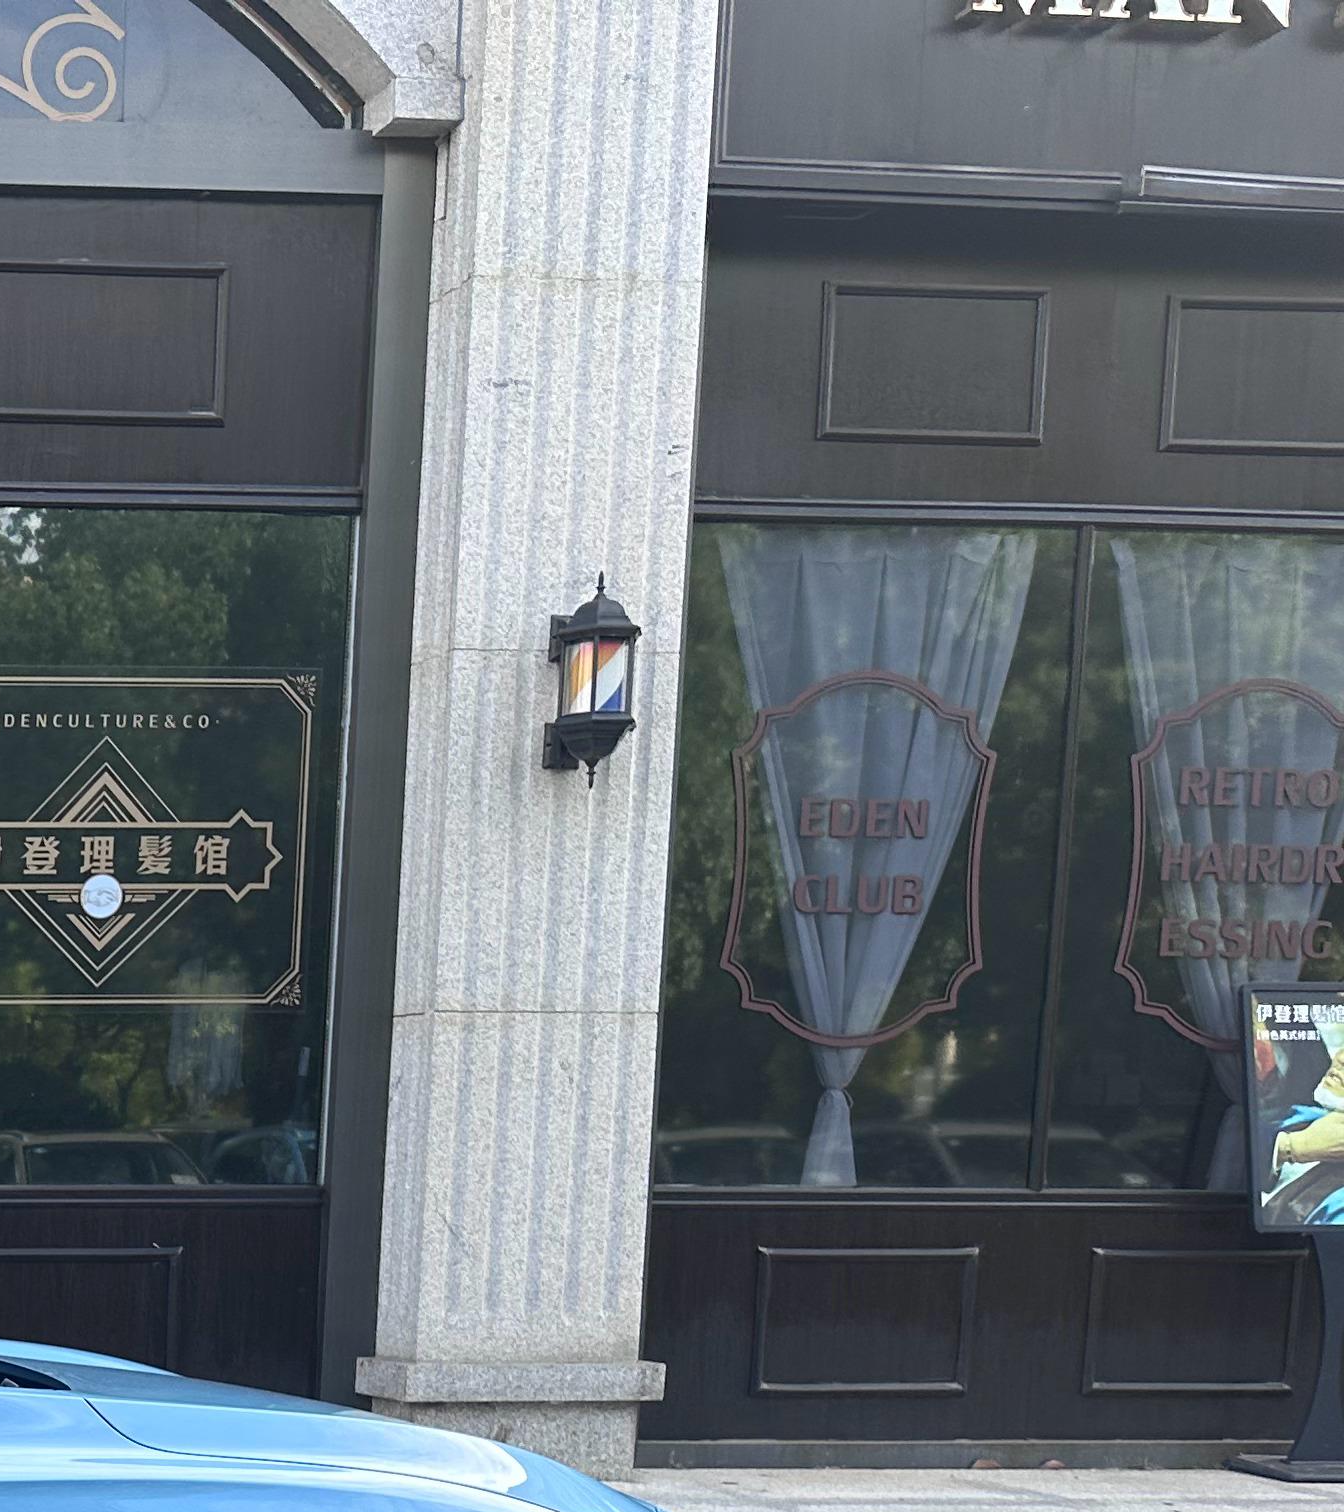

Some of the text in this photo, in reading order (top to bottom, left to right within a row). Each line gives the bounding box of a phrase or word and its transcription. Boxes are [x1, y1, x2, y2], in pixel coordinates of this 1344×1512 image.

[1178, 766, 1340, 808] RETRO
[799, 797, 930, 839] EDEN
[1160, 842, 1344, 884] HAIRDR
[793, 873, 924, 915] CLUB
[1159, 917, 1334, 960] ESSING
